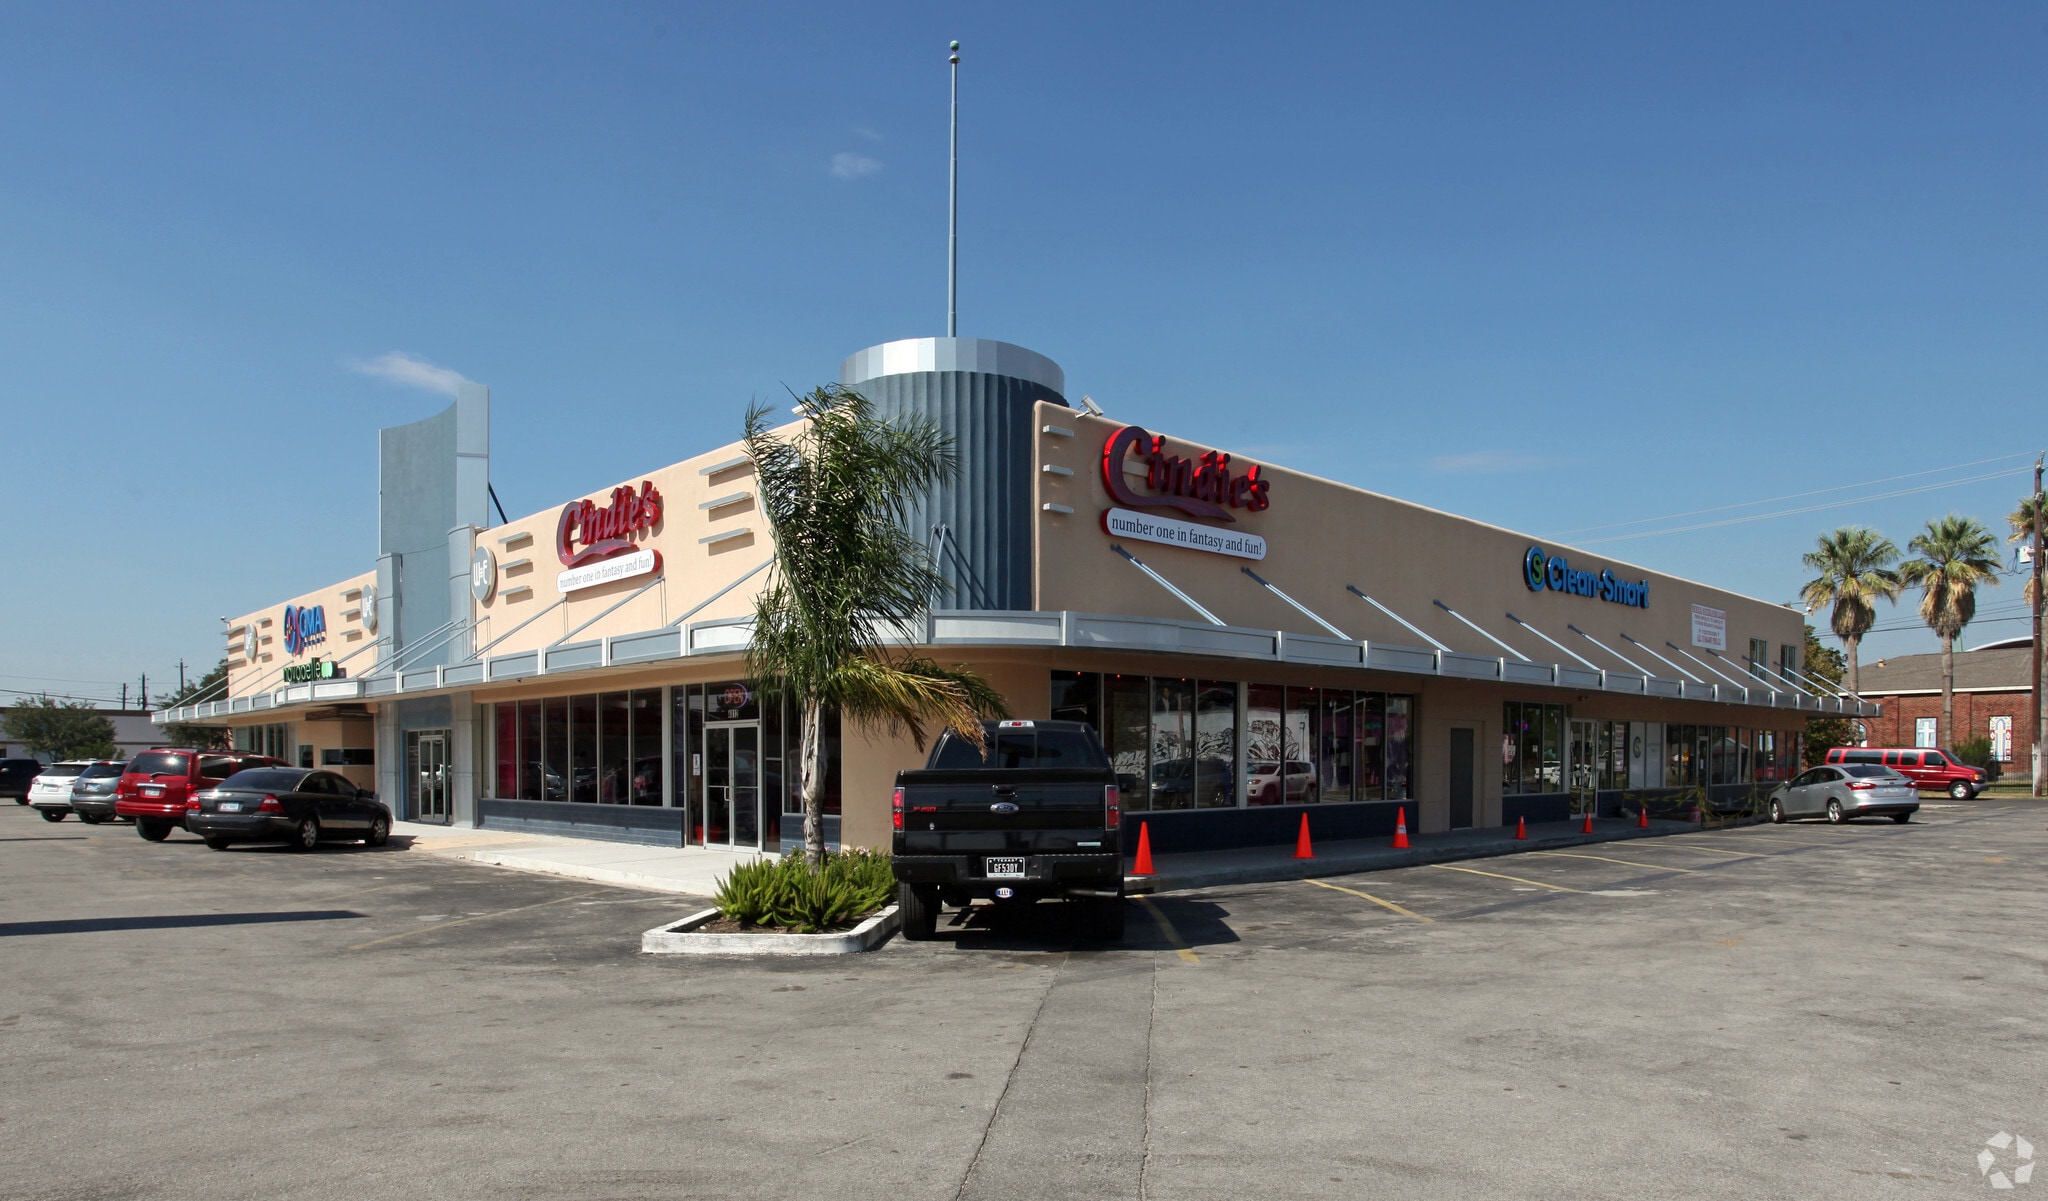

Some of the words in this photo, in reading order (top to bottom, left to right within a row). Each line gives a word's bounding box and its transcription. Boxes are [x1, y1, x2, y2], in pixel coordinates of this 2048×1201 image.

[1101, 425, 1270, 522] Cindie's
[556, 480, 663, 566] Cindie's
[1111, 517, 1155, 536] number
[1156, 528, 1175, 540] one
[1177, 526, 1187, 541] in
[1189, 529, 1223, 552] fantasy
[1225, 538, 1243, 552] and
[1244, 539, 1262, 555] fun!
[559, 573, 582, 588] number
[582, 573, 594, 583] one
[594, 569, 601, 580] in
[602, 563, 624, 578] fantasy
[624, 558, 638, 572] and
[638, 554, 652, 570] fun!
[1546, 555, 1650, 609] Clean-Smart
[724, 688, 744, 705] OPEN
